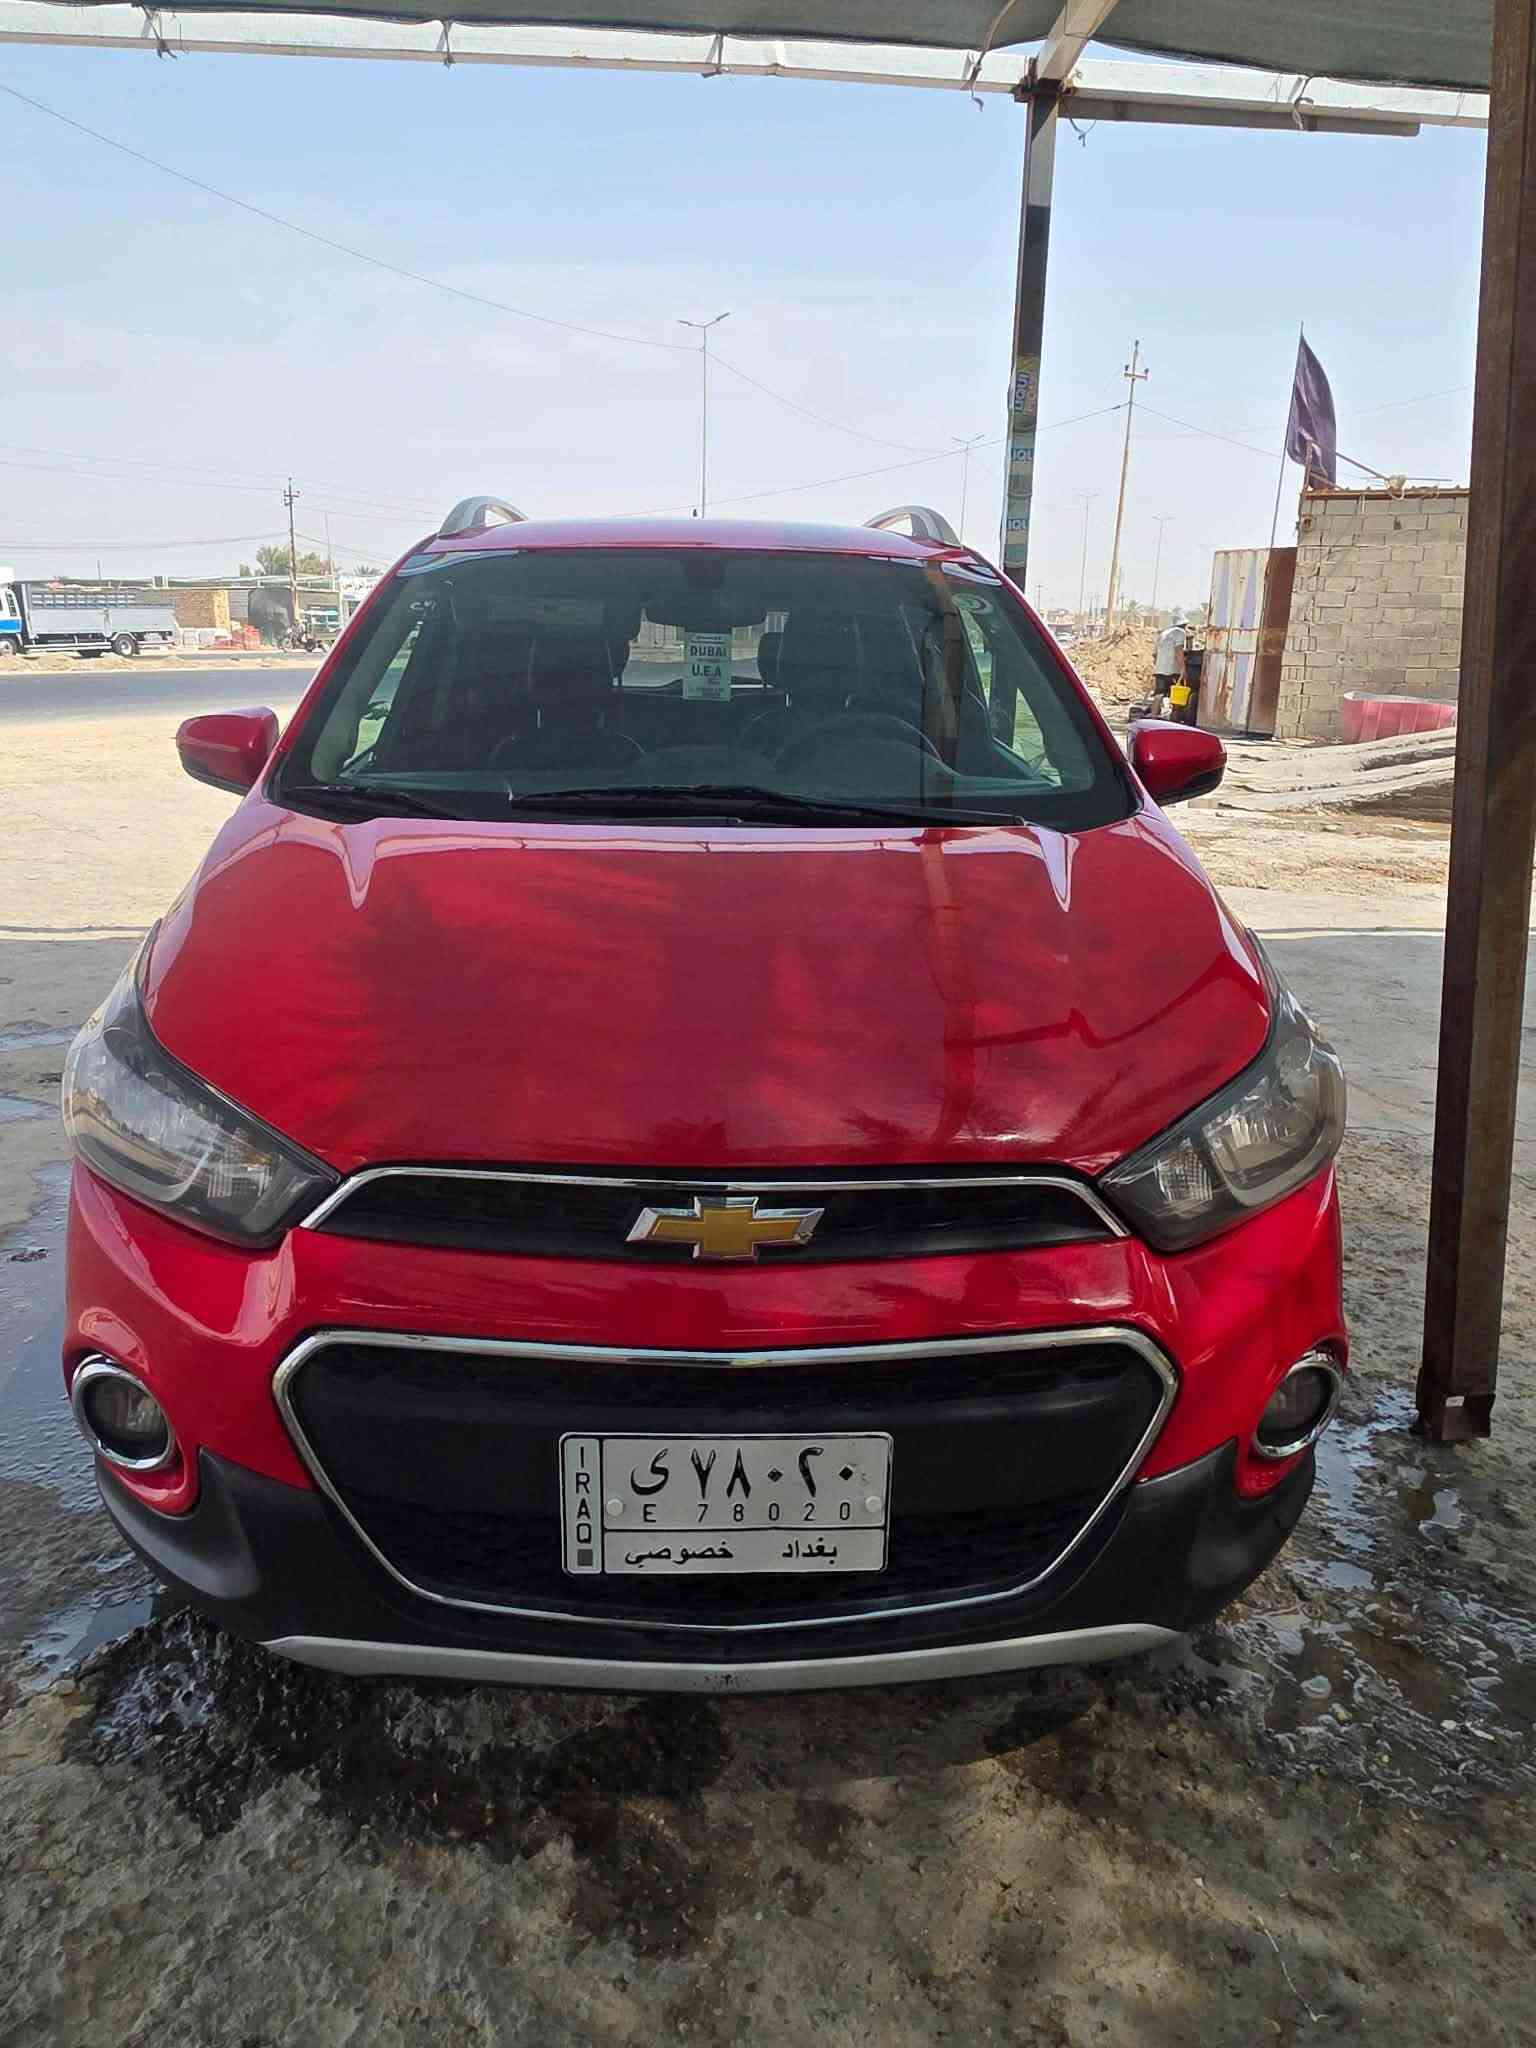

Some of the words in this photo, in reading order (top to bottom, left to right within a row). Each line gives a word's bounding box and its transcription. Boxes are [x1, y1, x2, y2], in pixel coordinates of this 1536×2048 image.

[690, 645, 727, 657] DUBAI
[690, 1446, 856, 1499] ٧٨٠٢٠
[575, 1446, 593, 1544] IRAQ
[642, 1503, 657, 1523] E
[697, 1502, 851, 1523] 78020
[781, 1537, 838, 1565] بغداد
